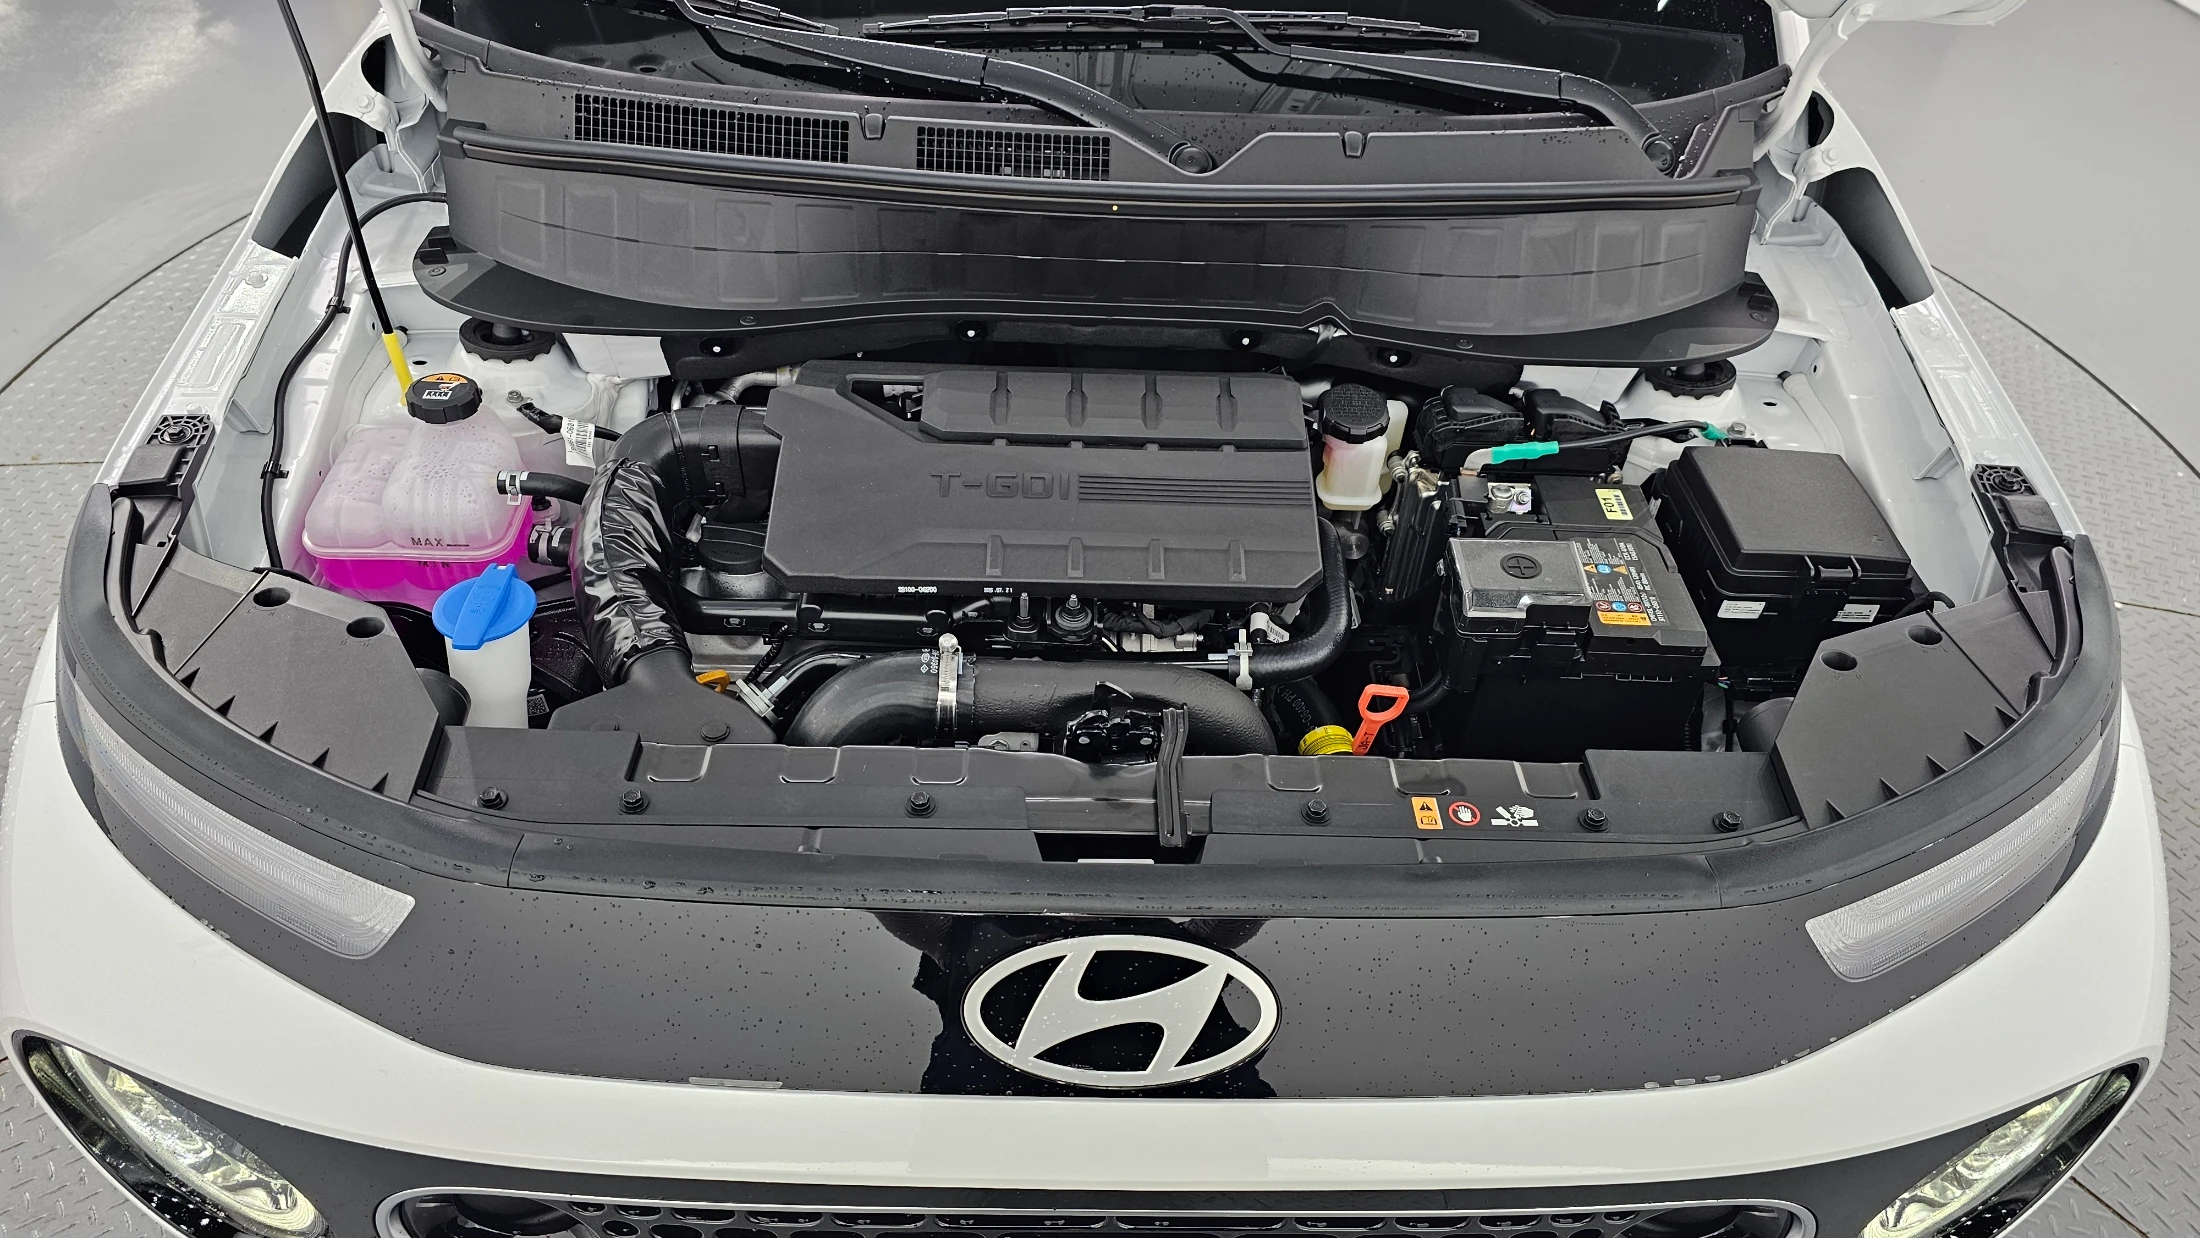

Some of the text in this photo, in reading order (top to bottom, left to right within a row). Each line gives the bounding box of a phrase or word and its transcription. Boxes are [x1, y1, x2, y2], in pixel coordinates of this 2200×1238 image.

[930, 472, 1070, 500] T-GDI
[1601, 497, 1617, 513] F01
[411, 537, 443, 547] MAX
